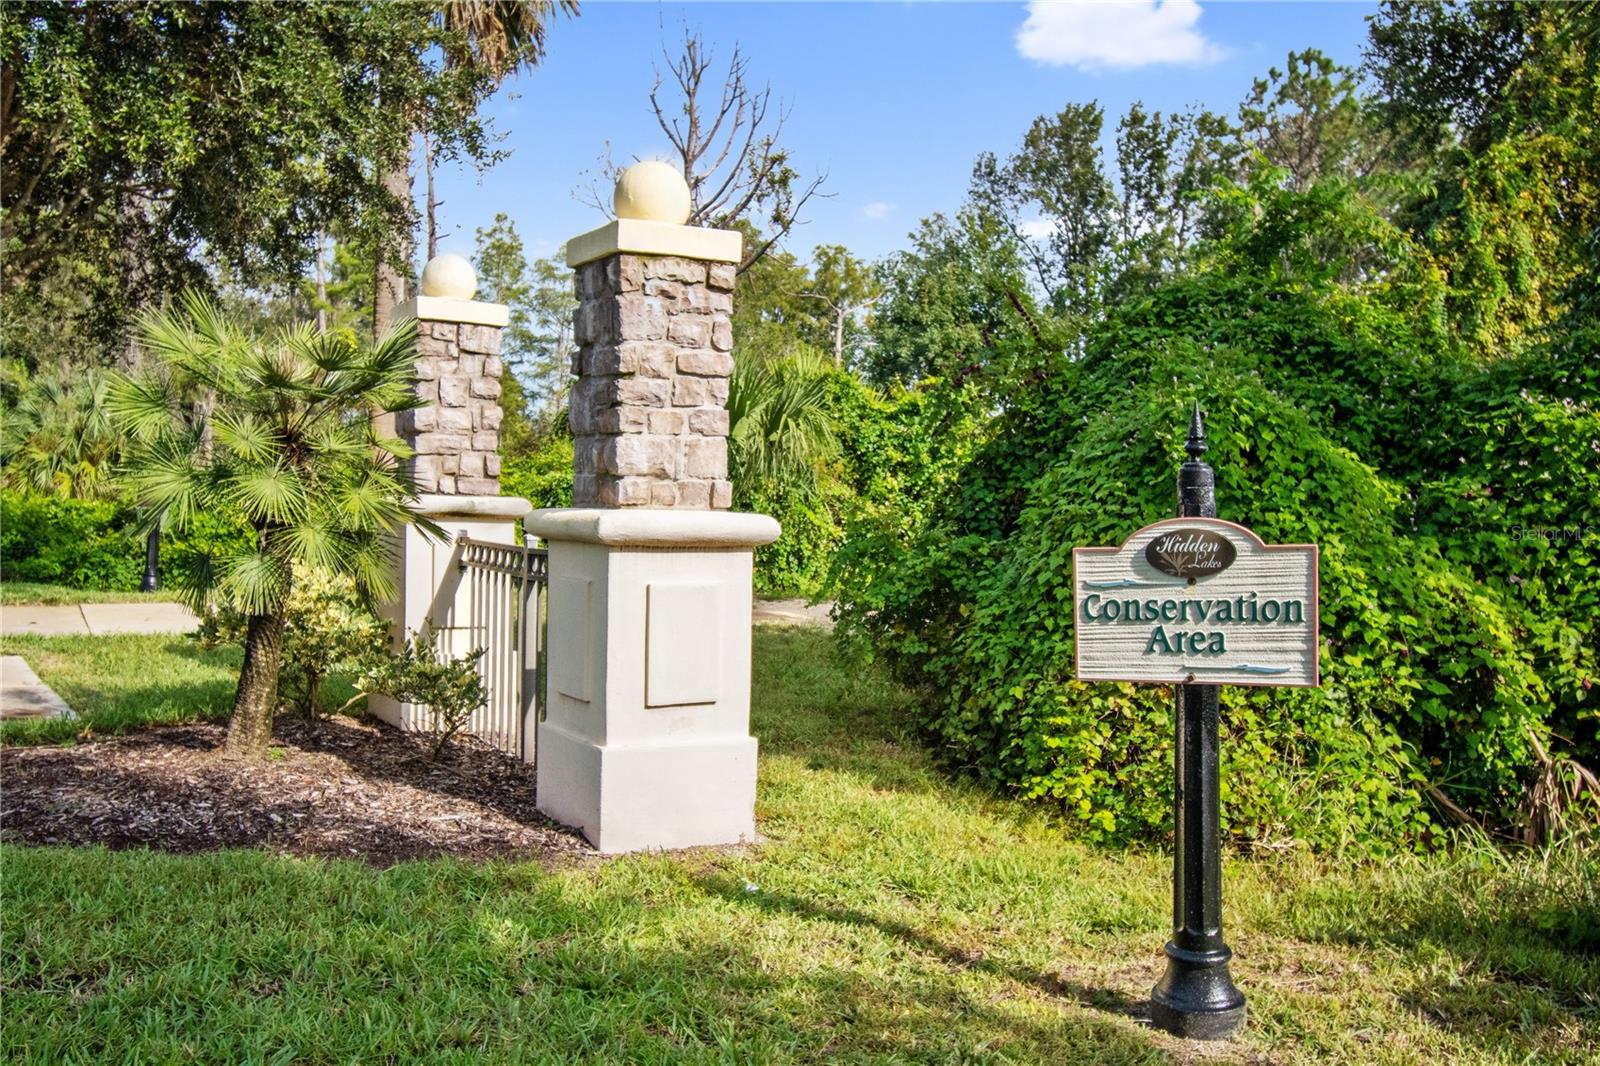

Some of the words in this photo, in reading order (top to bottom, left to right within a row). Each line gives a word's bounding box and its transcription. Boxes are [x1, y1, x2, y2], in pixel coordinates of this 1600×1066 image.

[1156, 534, 1221, 558] Hidden
[1188, 551, 1222, 569] Lakes
[1083, 591, 1305, 623] Conservation
[1146, 625, 1227, 655] Area
